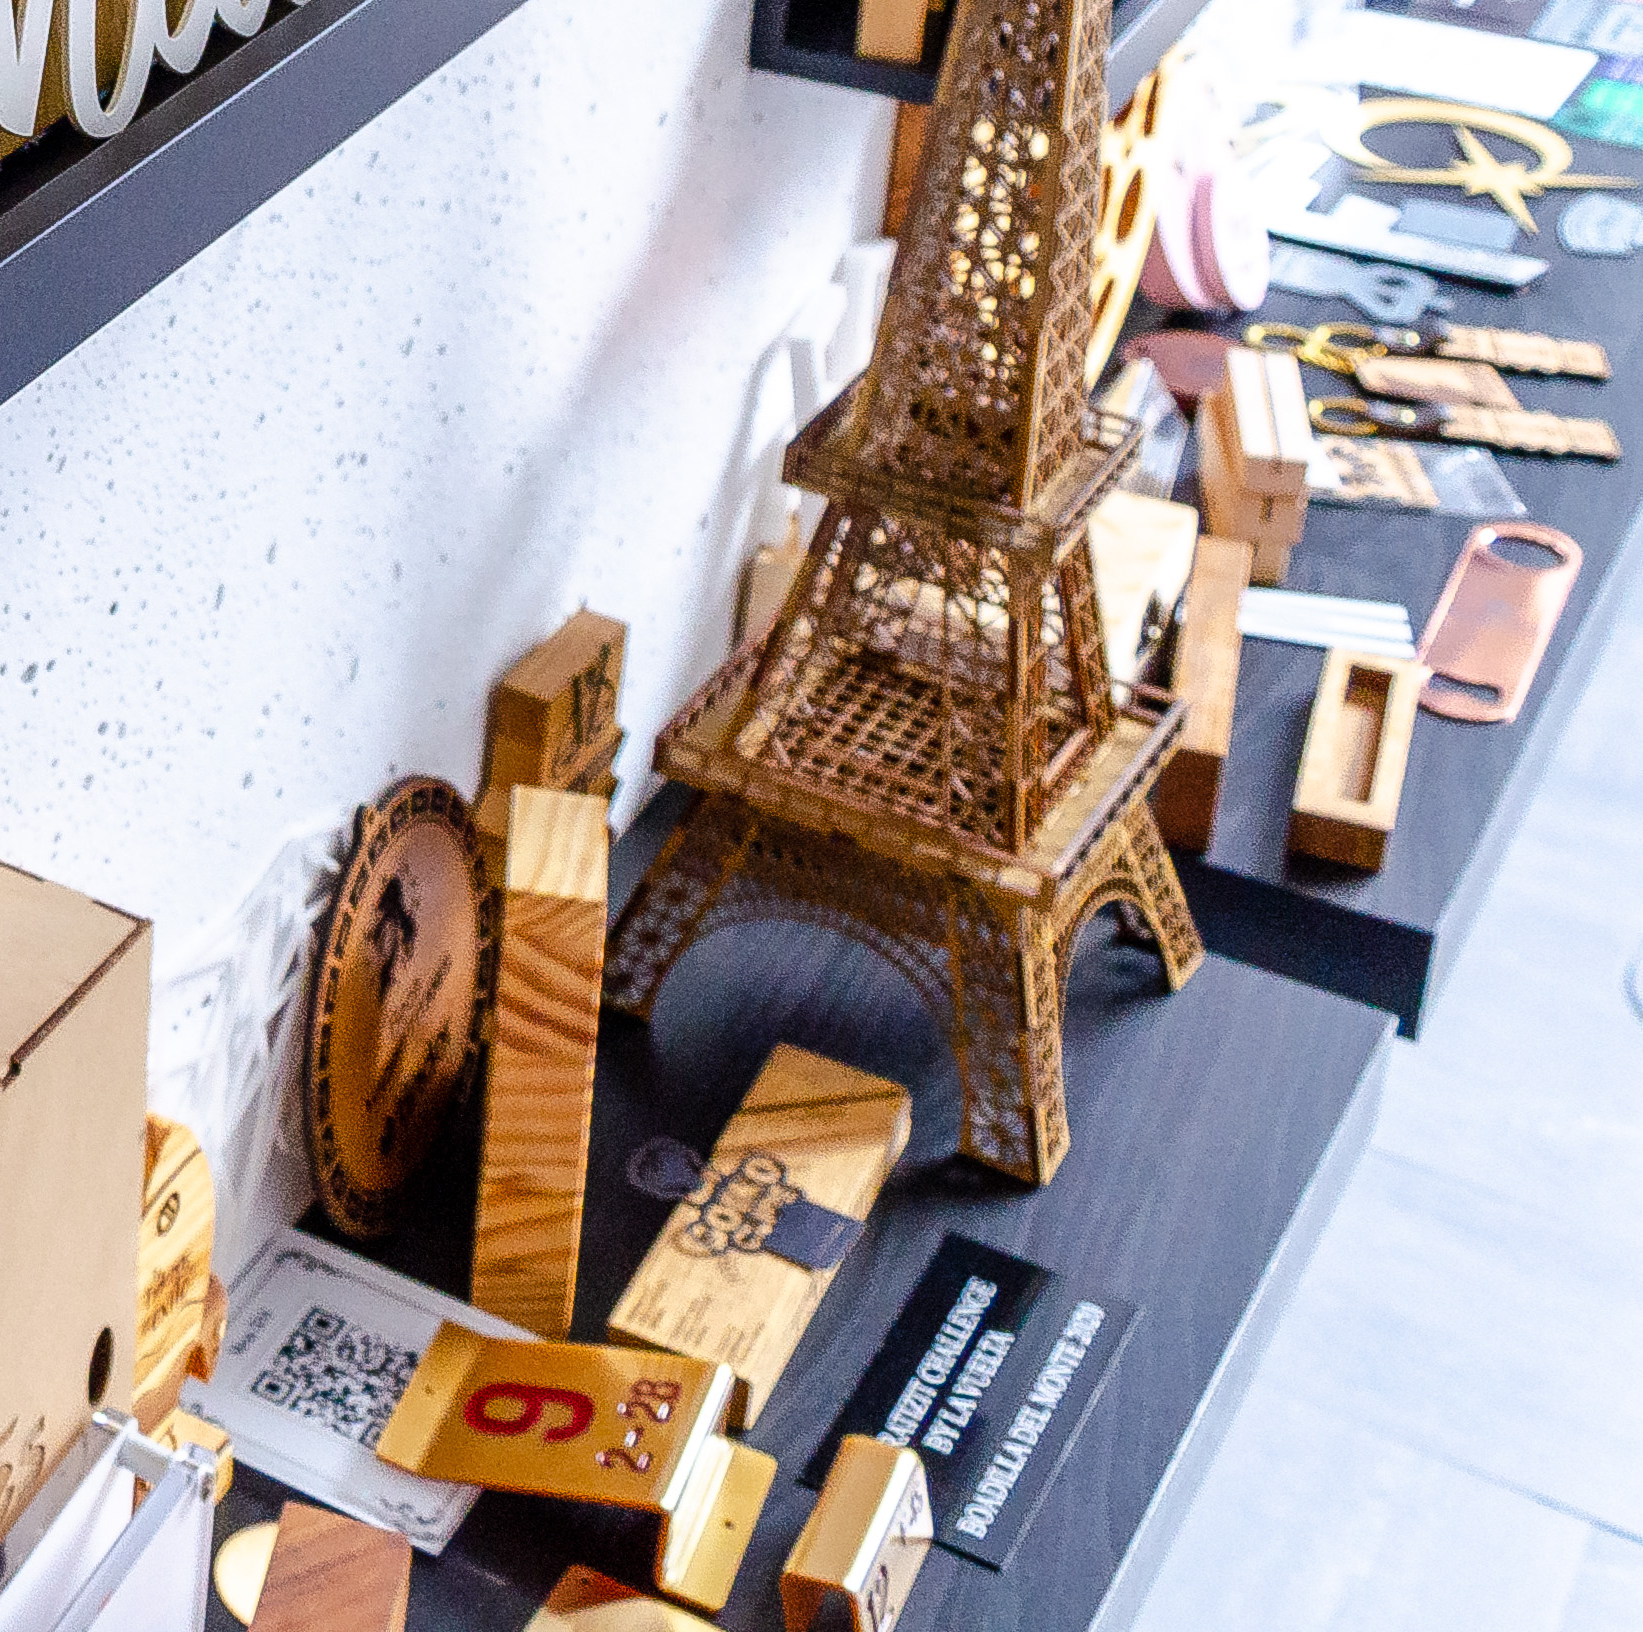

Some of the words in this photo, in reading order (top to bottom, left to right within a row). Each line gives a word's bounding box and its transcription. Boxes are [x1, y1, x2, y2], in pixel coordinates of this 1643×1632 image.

[915, 1273, 998, 1387] CHALLENGE
[954, 1324, 1014, 1400] VUELTA
[1028, 1338, 1085, 1409] MONTE
[924, 1420, 959, 1455] BY
[938, 1391, 976, 1429] LA
[1009, 1400, 1051, 1446] DEL
[957, 1437, 1031, 1538] BOADILLA
